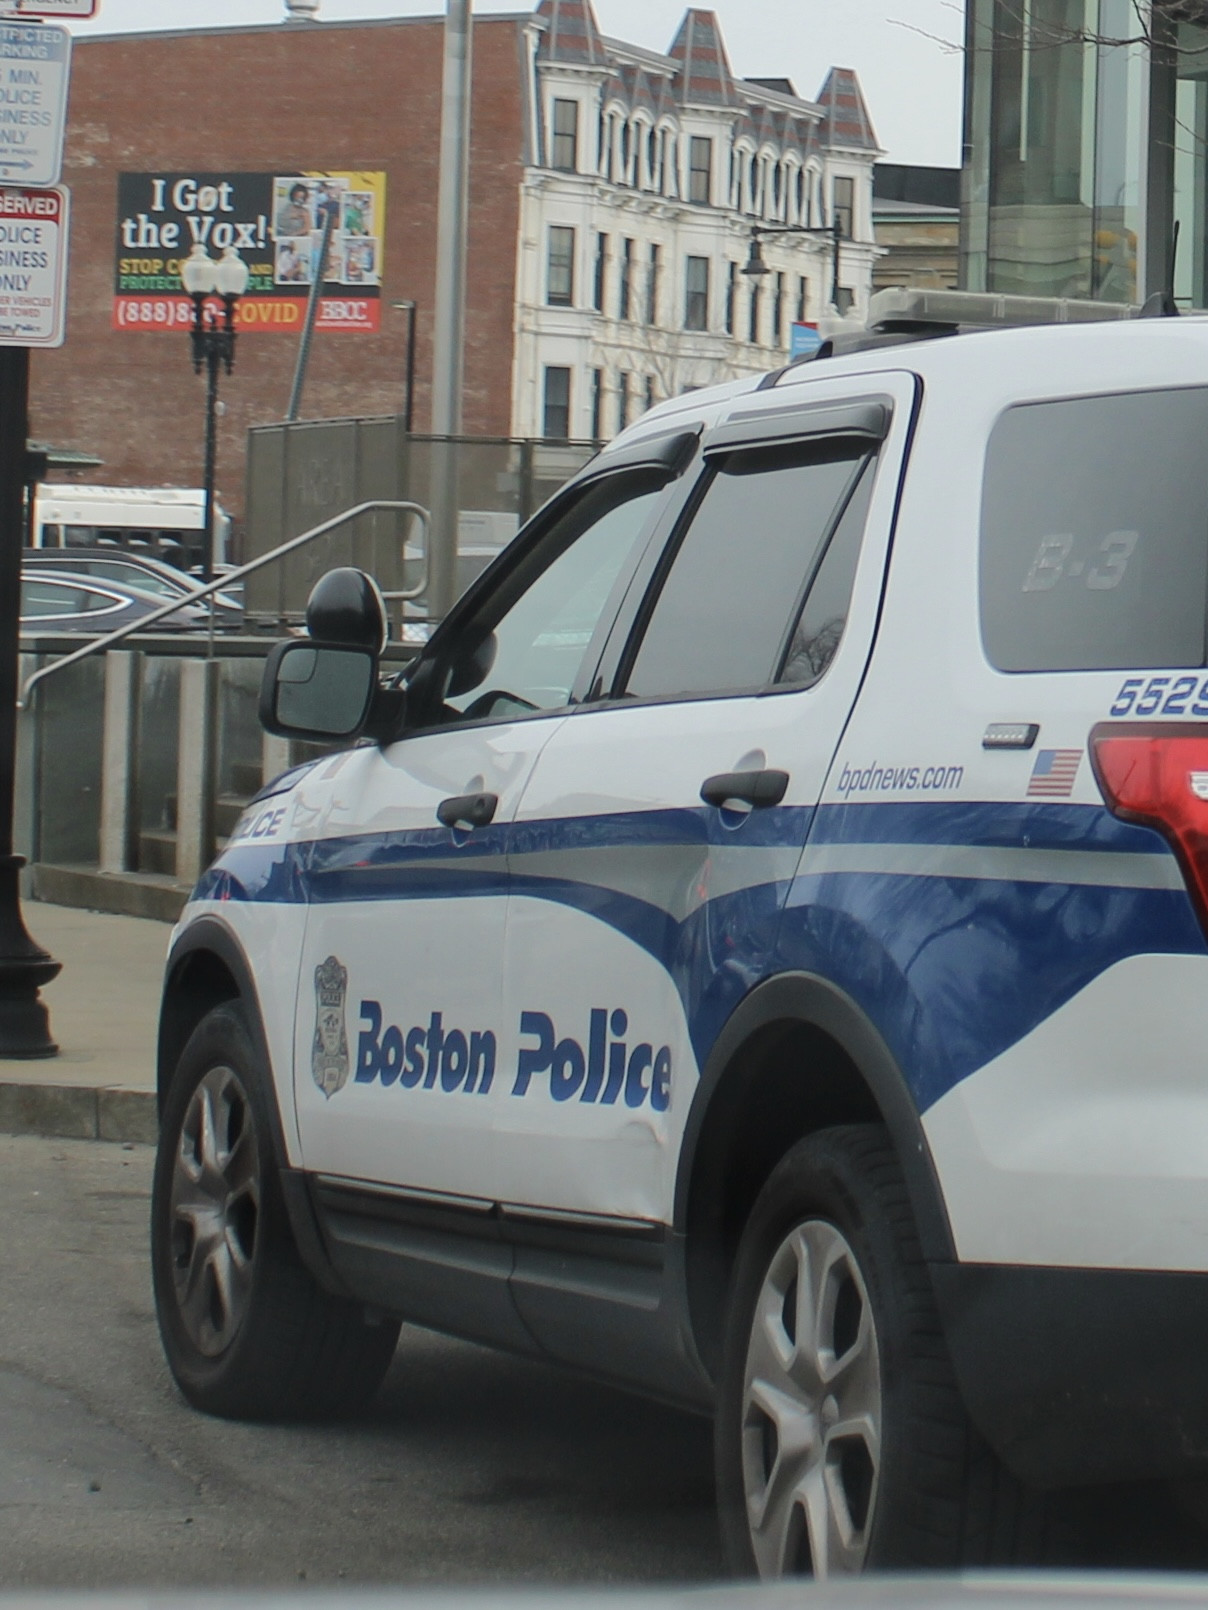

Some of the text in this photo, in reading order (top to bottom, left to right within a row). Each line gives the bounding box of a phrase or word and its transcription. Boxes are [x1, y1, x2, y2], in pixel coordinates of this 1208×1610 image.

[0, 28, 62, 43] TRICTED
[0, 44, 48, 58] RKING
[0, 109, 51, 127] INESS
[0, 129, 29, 145] NLY
[151, 178, 234, 212] I Got
[121, 213, 267, 249] the Vox!
[119, 258, 164, 274] STOP
[0, 274, 32, 291] NLY
[1021, 530, 1139, 592] B-3
[837, 760, 964, 800] bpdnews.com
[354, 1000, 672, 1113] Boston Police
